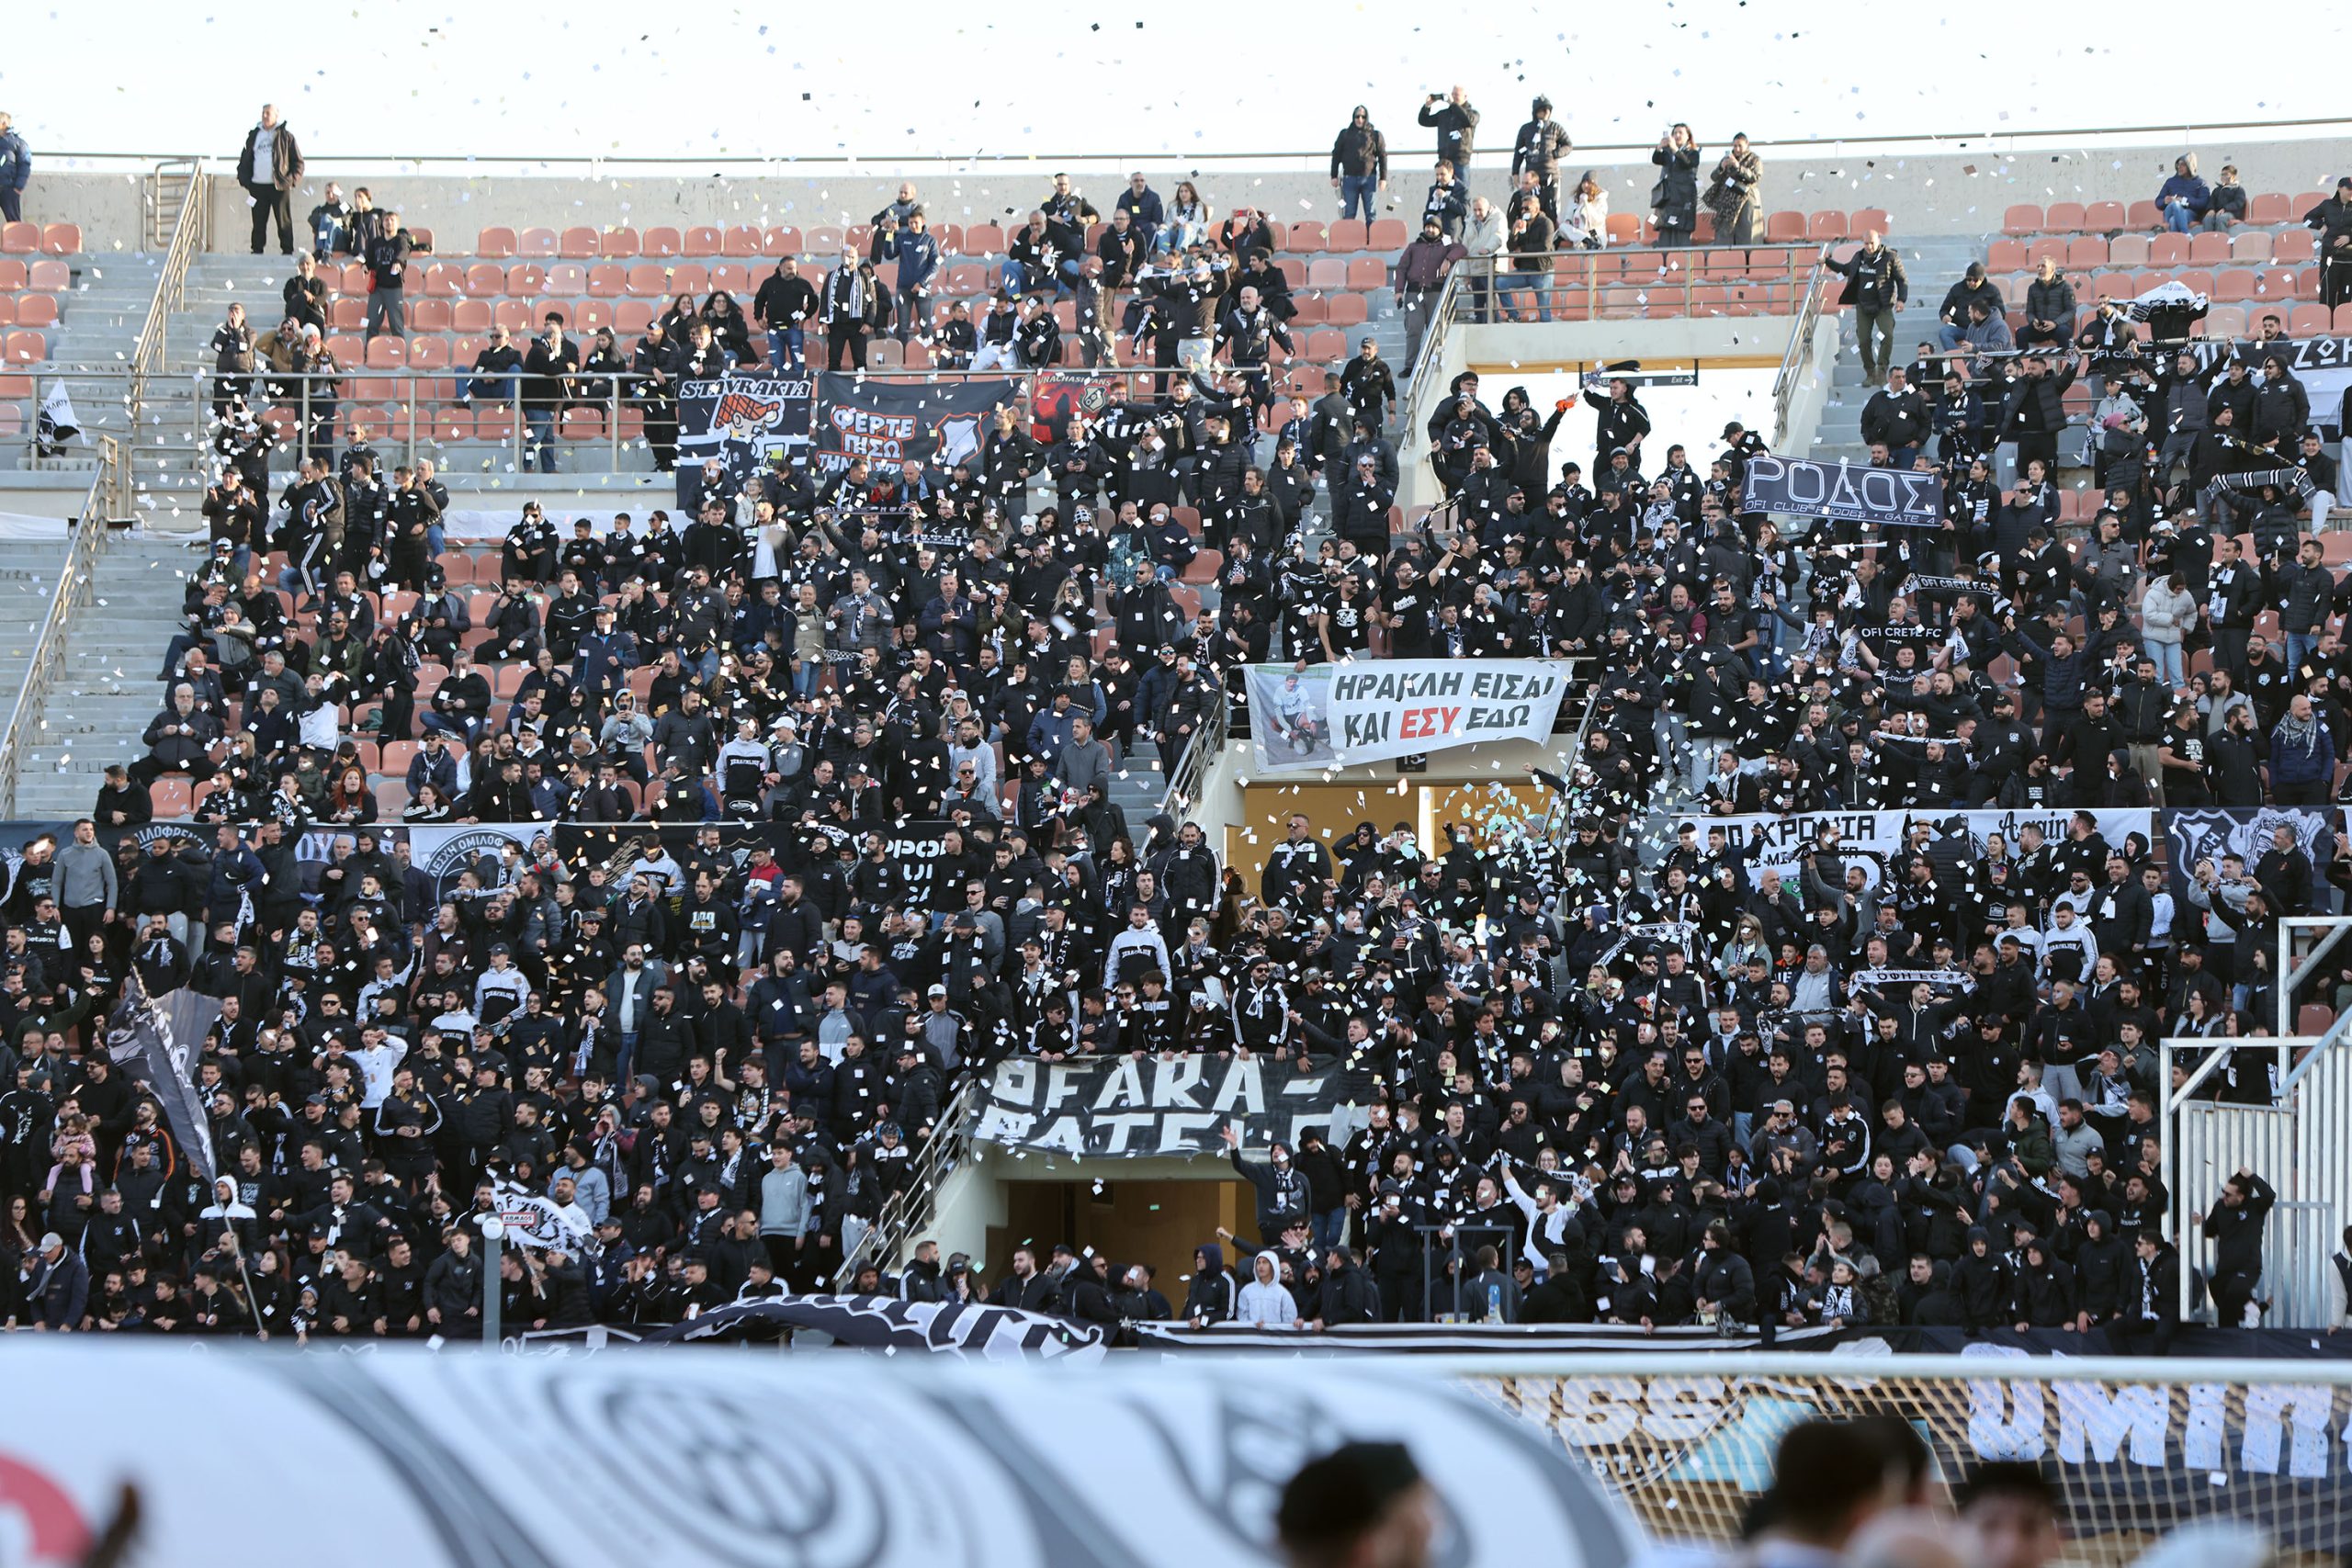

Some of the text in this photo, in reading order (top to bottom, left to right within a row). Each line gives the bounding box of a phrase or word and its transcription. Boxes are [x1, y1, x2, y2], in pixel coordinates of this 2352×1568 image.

[679, 377, 813, 400] STAVRAKIA
[1671, 375, 1684, 384] Exit
[832, 408, 914, 439] ΦΕΡΤΕ
[1746, 457, 1937, 515] ΡΟΔΟΣ
[1746, 500, 1767, 511] OFI
[1773, 501, 1808, 513] CLUB
[1884, 513, 1920, 524] GATE
[1923, 579, 1938, 588] OFI
[1939, 580, 1972, 591] CRETE
[1861, 626, 1942, 637] OFI CRETE FC
[1335, 671, 1555, 703] ΗΡΑΚΛΗ ΕΙΣΑΙ
[1344, 705, 1531, 748] ΚΑΙ ΕΣΥ ΕΔΩ
[1753, 814, 1876, 848] ΧΡΟΙΑ
[428, 834, 504, 878] ΛΕΣΧΗ ΟΜΙΛΟΦ
